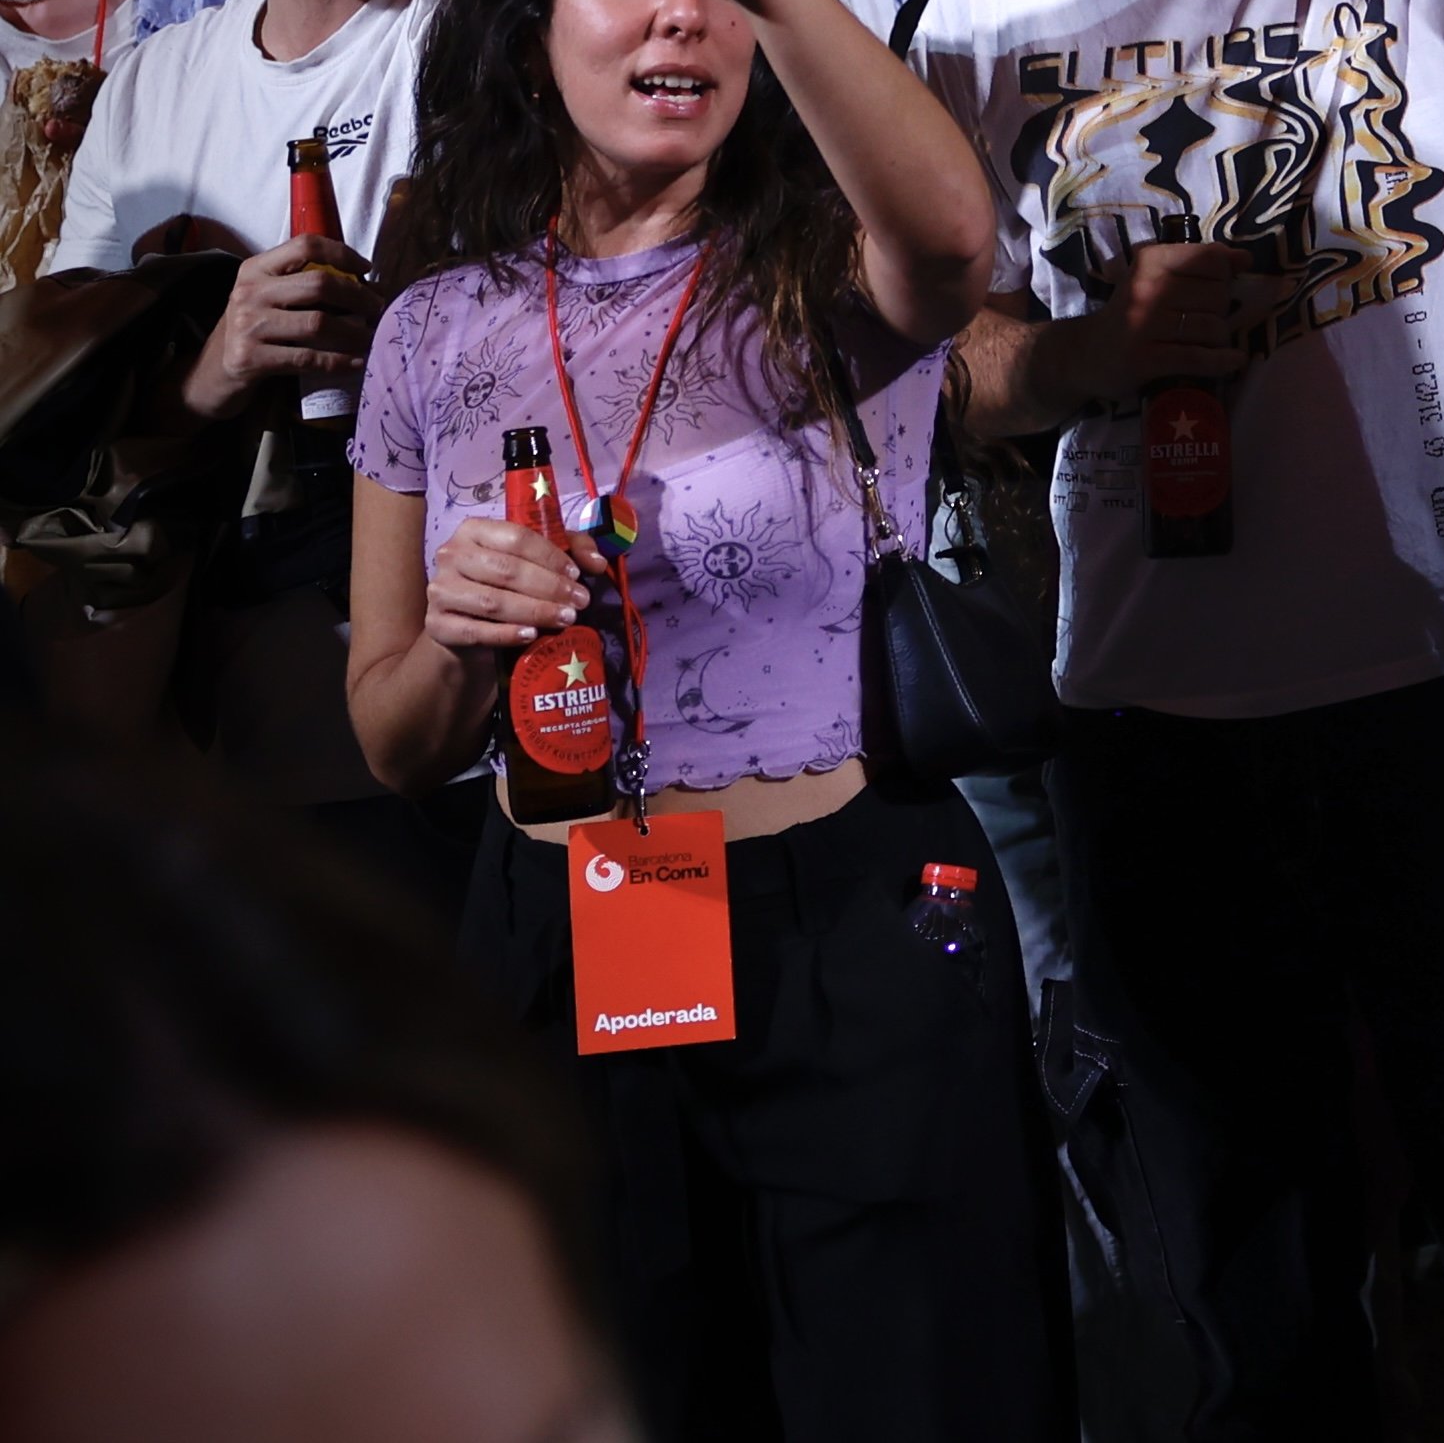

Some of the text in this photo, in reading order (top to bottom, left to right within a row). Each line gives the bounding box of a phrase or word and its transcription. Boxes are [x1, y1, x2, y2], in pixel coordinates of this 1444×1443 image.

[1150, 442, 1220, 459] ESTRELLA
[565, 704, 594, 718] DAMM
[628, 851, 692, 868] Barcelona
[629, 860, 710, 885] En Comú
[594, 1003, 718, 1034] Apoderada
